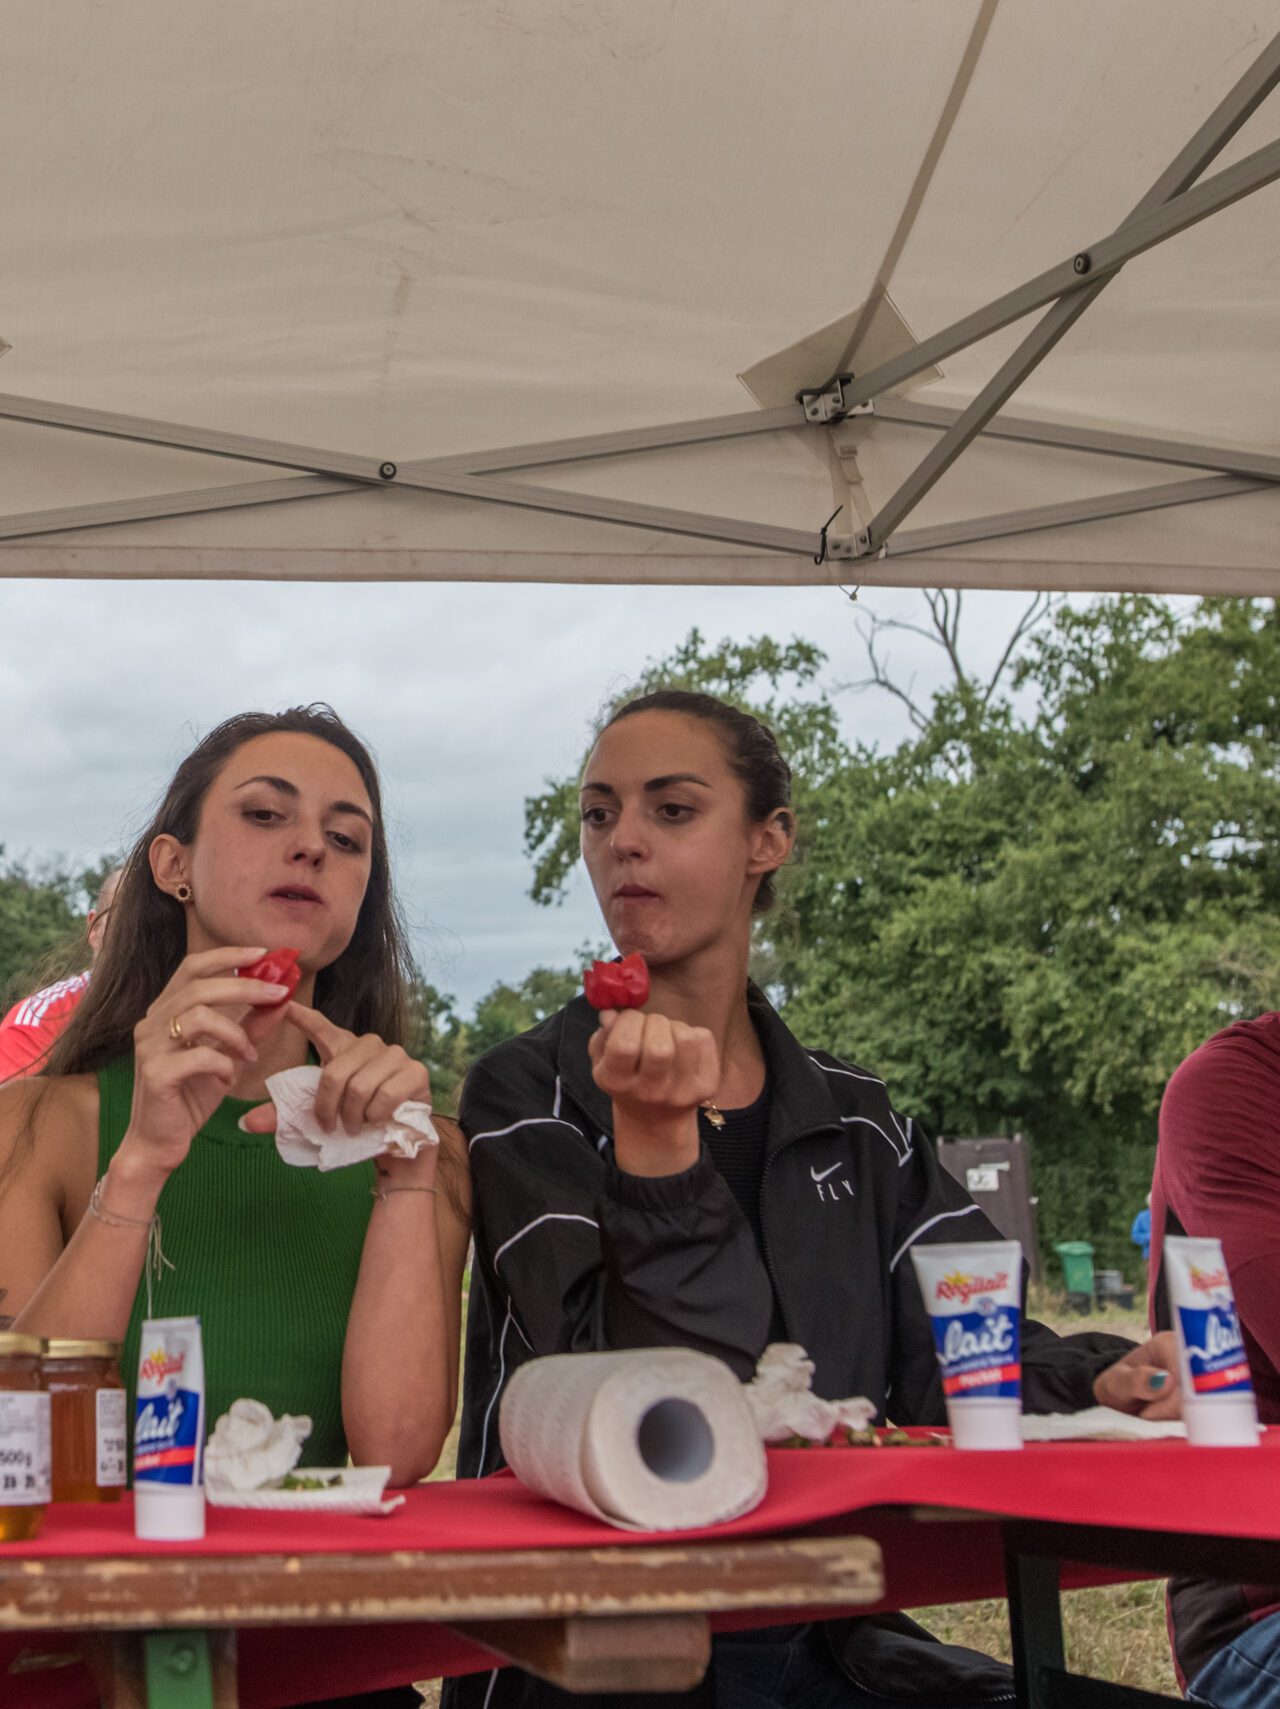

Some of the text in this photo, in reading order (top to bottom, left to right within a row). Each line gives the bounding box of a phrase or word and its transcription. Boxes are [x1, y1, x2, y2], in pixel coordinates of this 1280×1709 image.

[816, 1180, 854, 1201] FLY
[936, 1314, 1014, 1366] lait
[1190, 1312, 1244, 1359] lai
